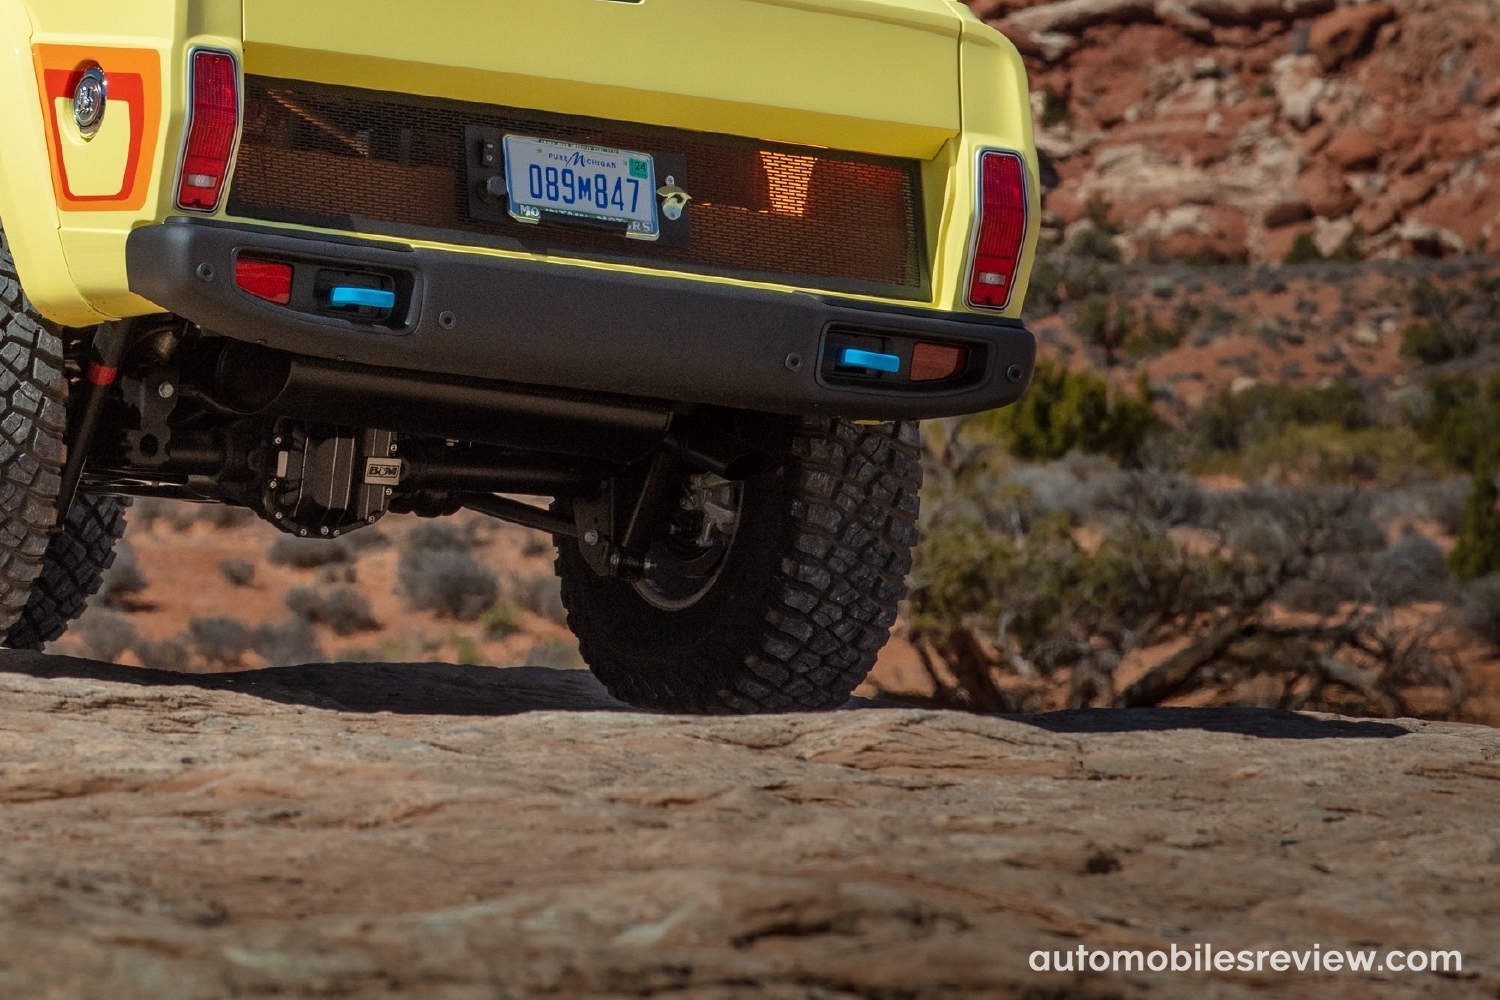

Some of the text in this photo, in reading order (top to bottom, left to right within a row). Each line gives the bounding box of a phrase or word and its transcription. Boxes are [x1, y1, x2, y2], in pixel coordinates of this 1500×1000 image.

[548, 151, 617, 168] PURE MICHIGAN
[634, 161, 647, 172] 24
[529, 163, 640, 213] 089M847
